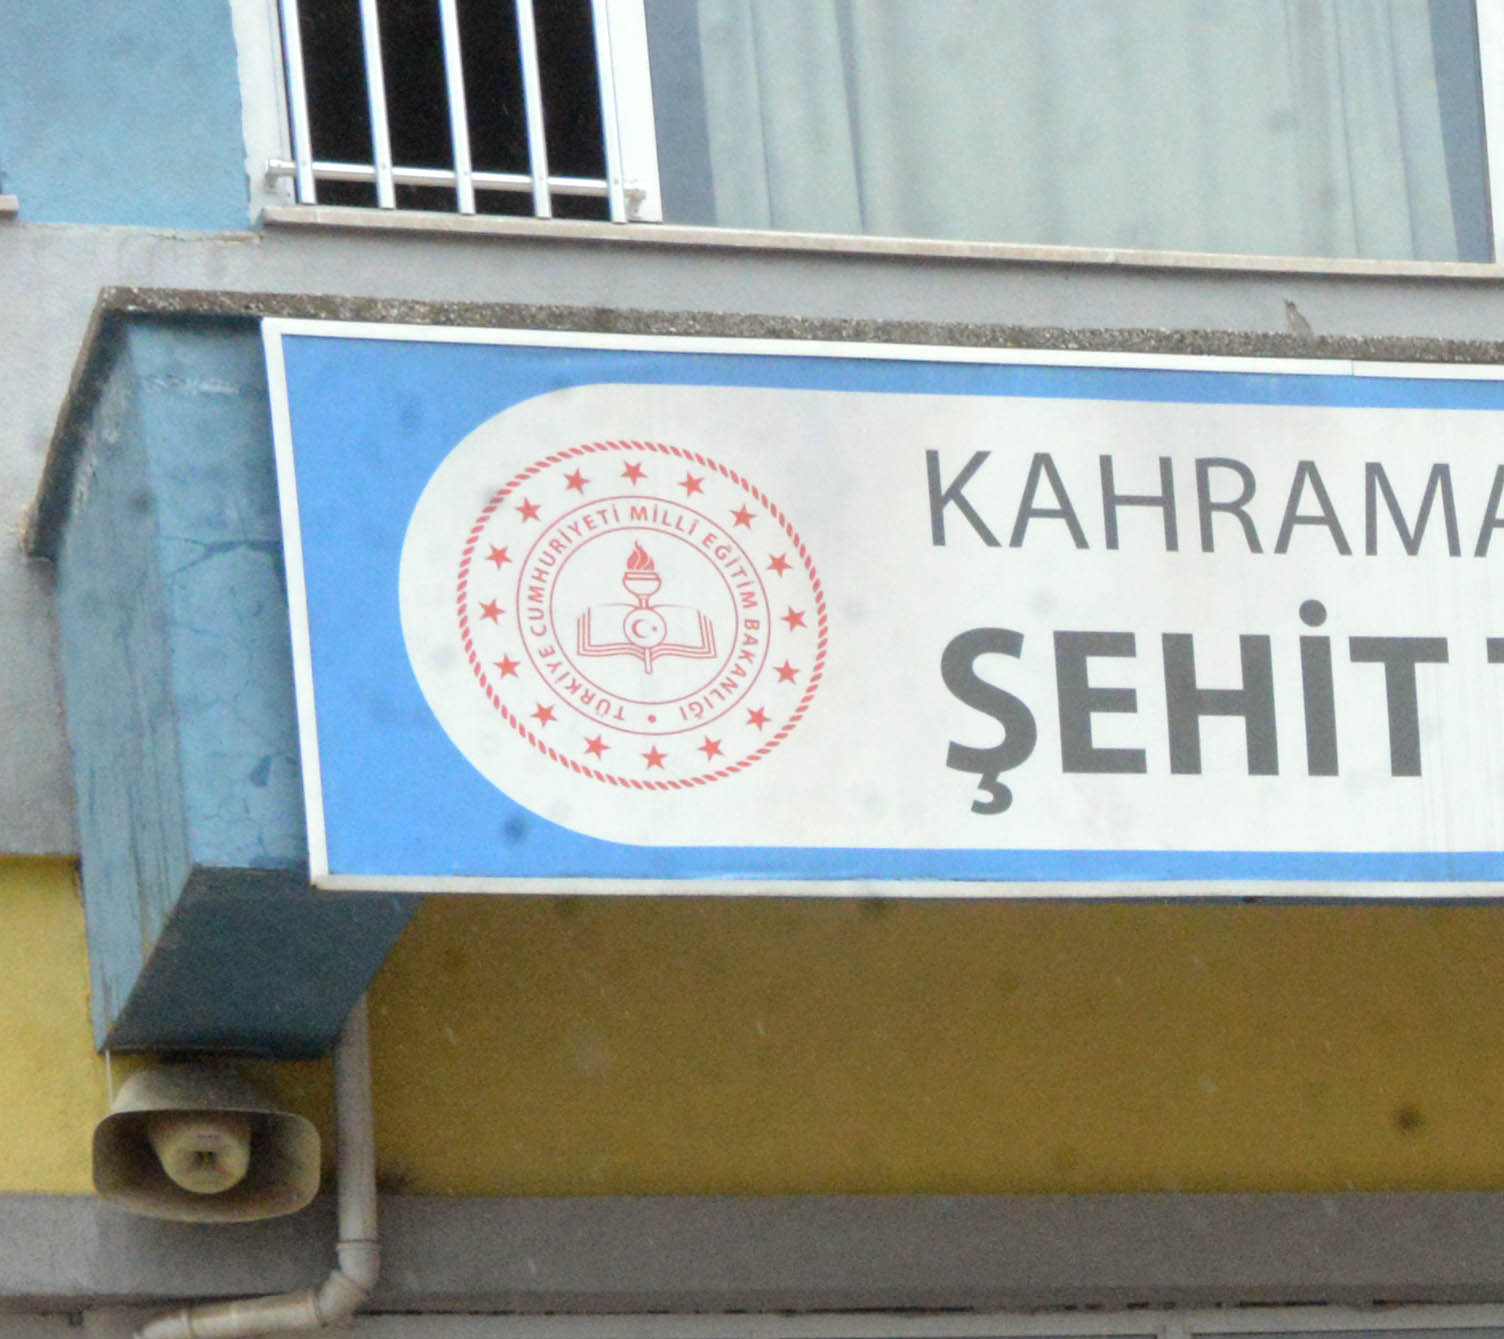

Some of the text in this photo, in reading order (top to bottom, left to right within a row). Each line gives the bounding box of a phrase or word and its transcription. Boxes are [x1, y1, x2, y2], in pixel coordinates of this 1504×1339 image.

[527, 503, 761, 722] TÜRKİYE CUMHURİYETİ MİLLİ EĞİTİM BAKANLIĞI
[941, 600, 1447, 815] ŞEHİT
